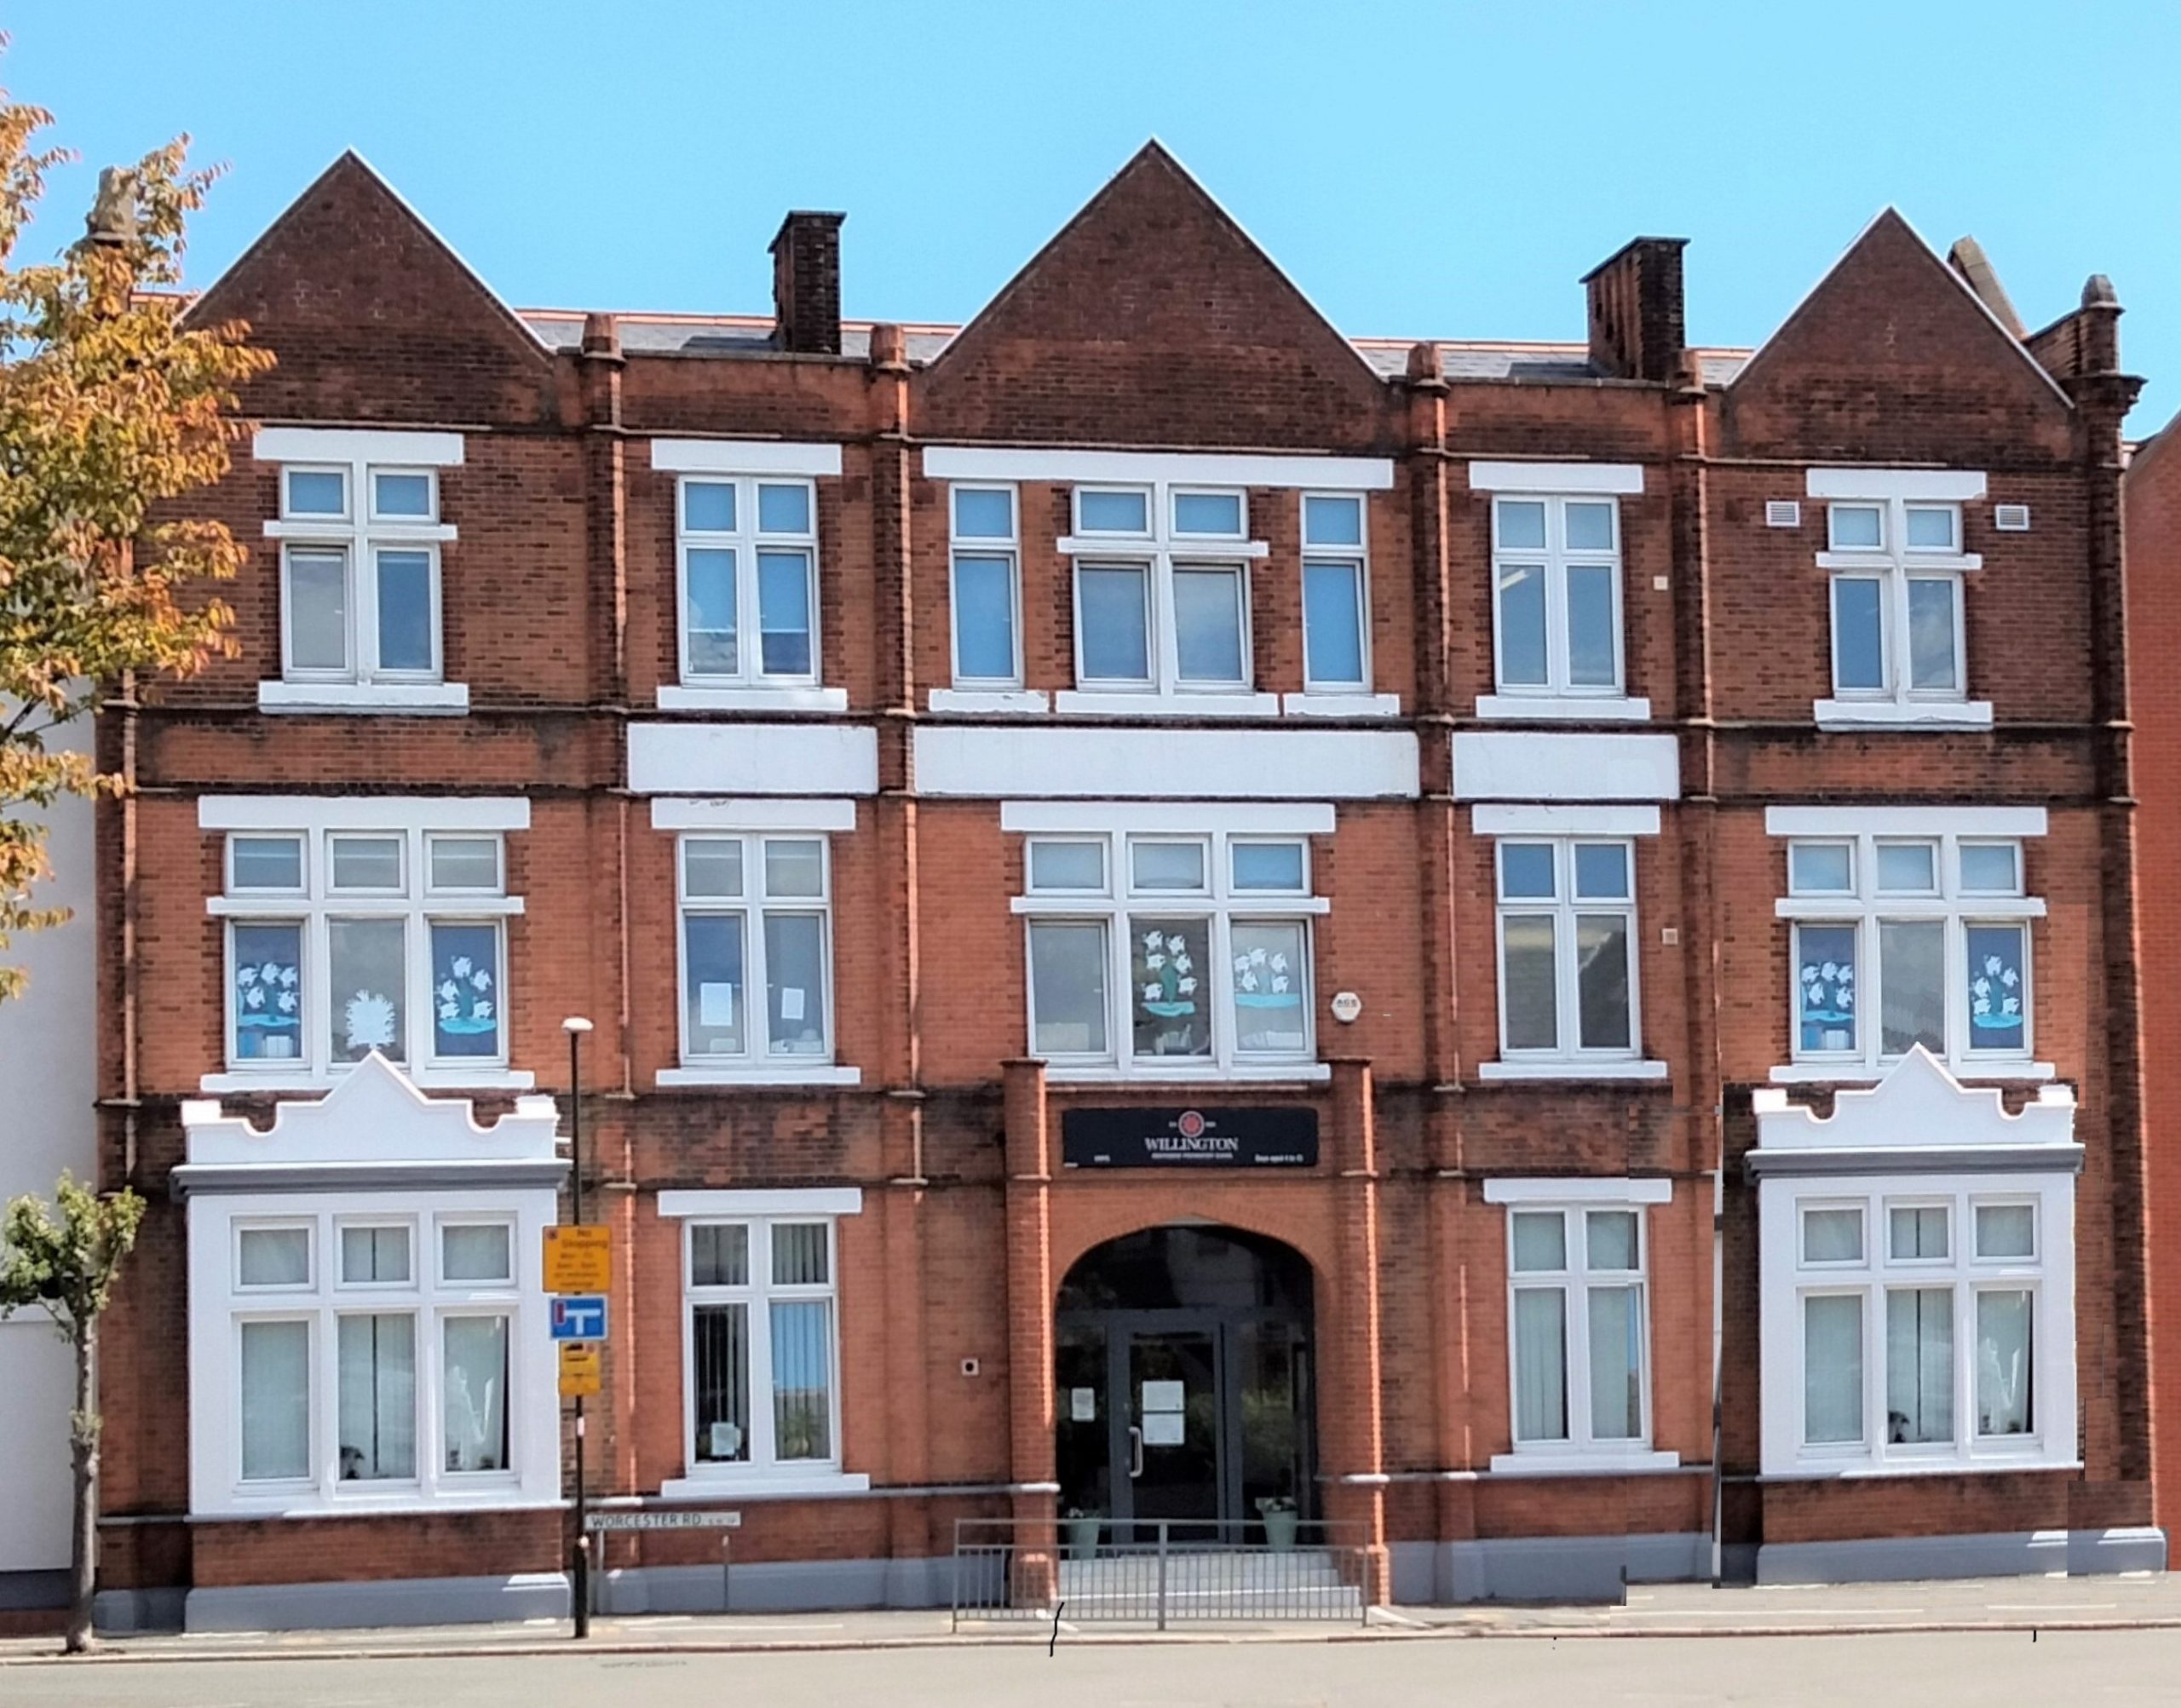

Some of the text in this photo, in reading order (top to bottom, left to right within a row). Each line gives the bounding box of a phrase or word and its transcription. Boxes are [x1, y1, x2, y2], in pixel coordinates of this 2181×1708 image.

[1144, 1137, 1239, 1150] WILLINGTON
[591, 1514, 678, 1527] WORCESTER
[682, 1514, 702, 1525] RD
